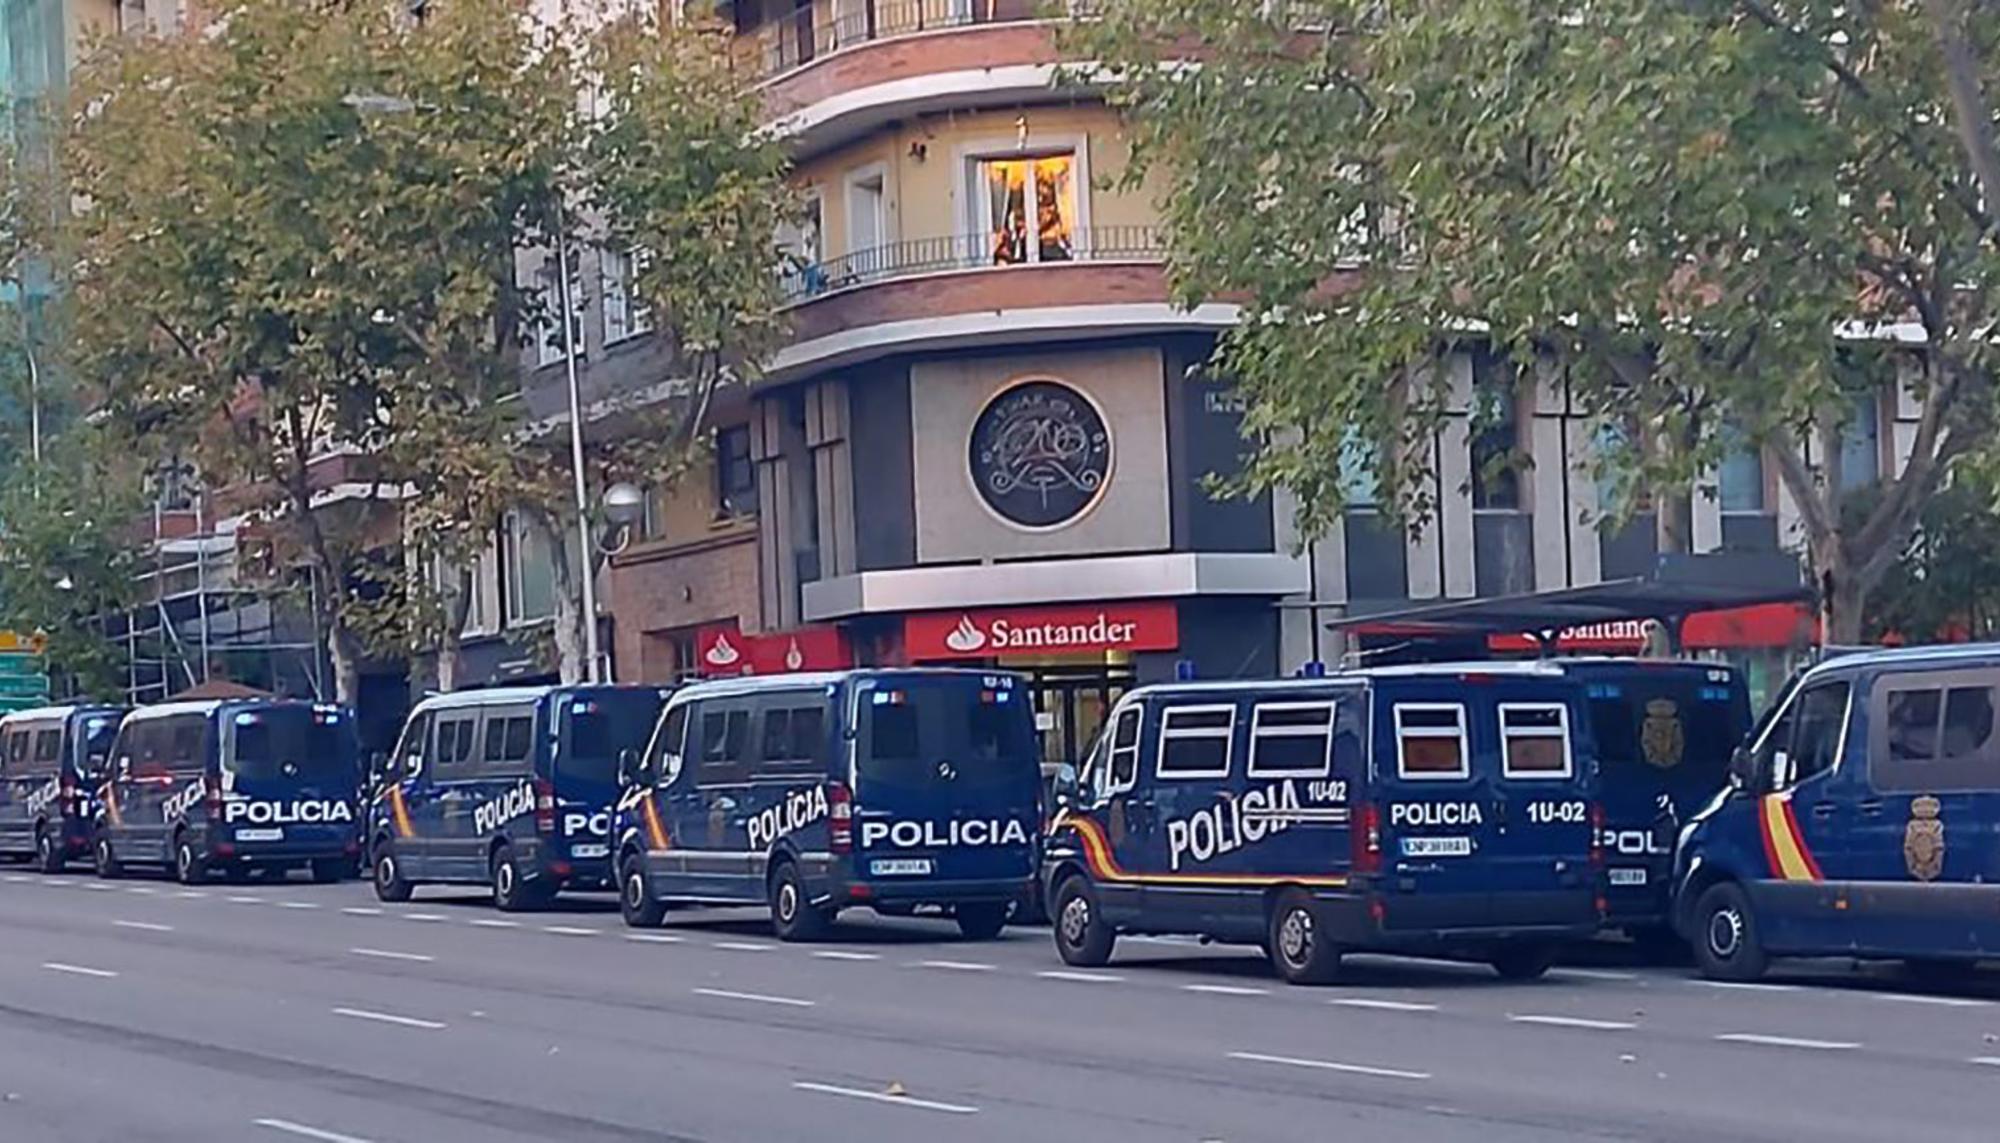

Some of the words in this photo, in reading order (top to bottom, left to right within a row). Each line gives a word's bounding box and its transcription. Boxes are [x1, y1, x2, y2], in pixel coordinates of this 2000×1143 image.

[992, 613, 1136, 647] Santander
[1308, 781, 1347, 802] 1U-02
[225, 801, 352, 823] POLICIA
[1391, 803, 1483, 825] POLICIA
[1526, 801, 1586, 823] 1U-02
[862, 819, 1027, 848] POLICIA
